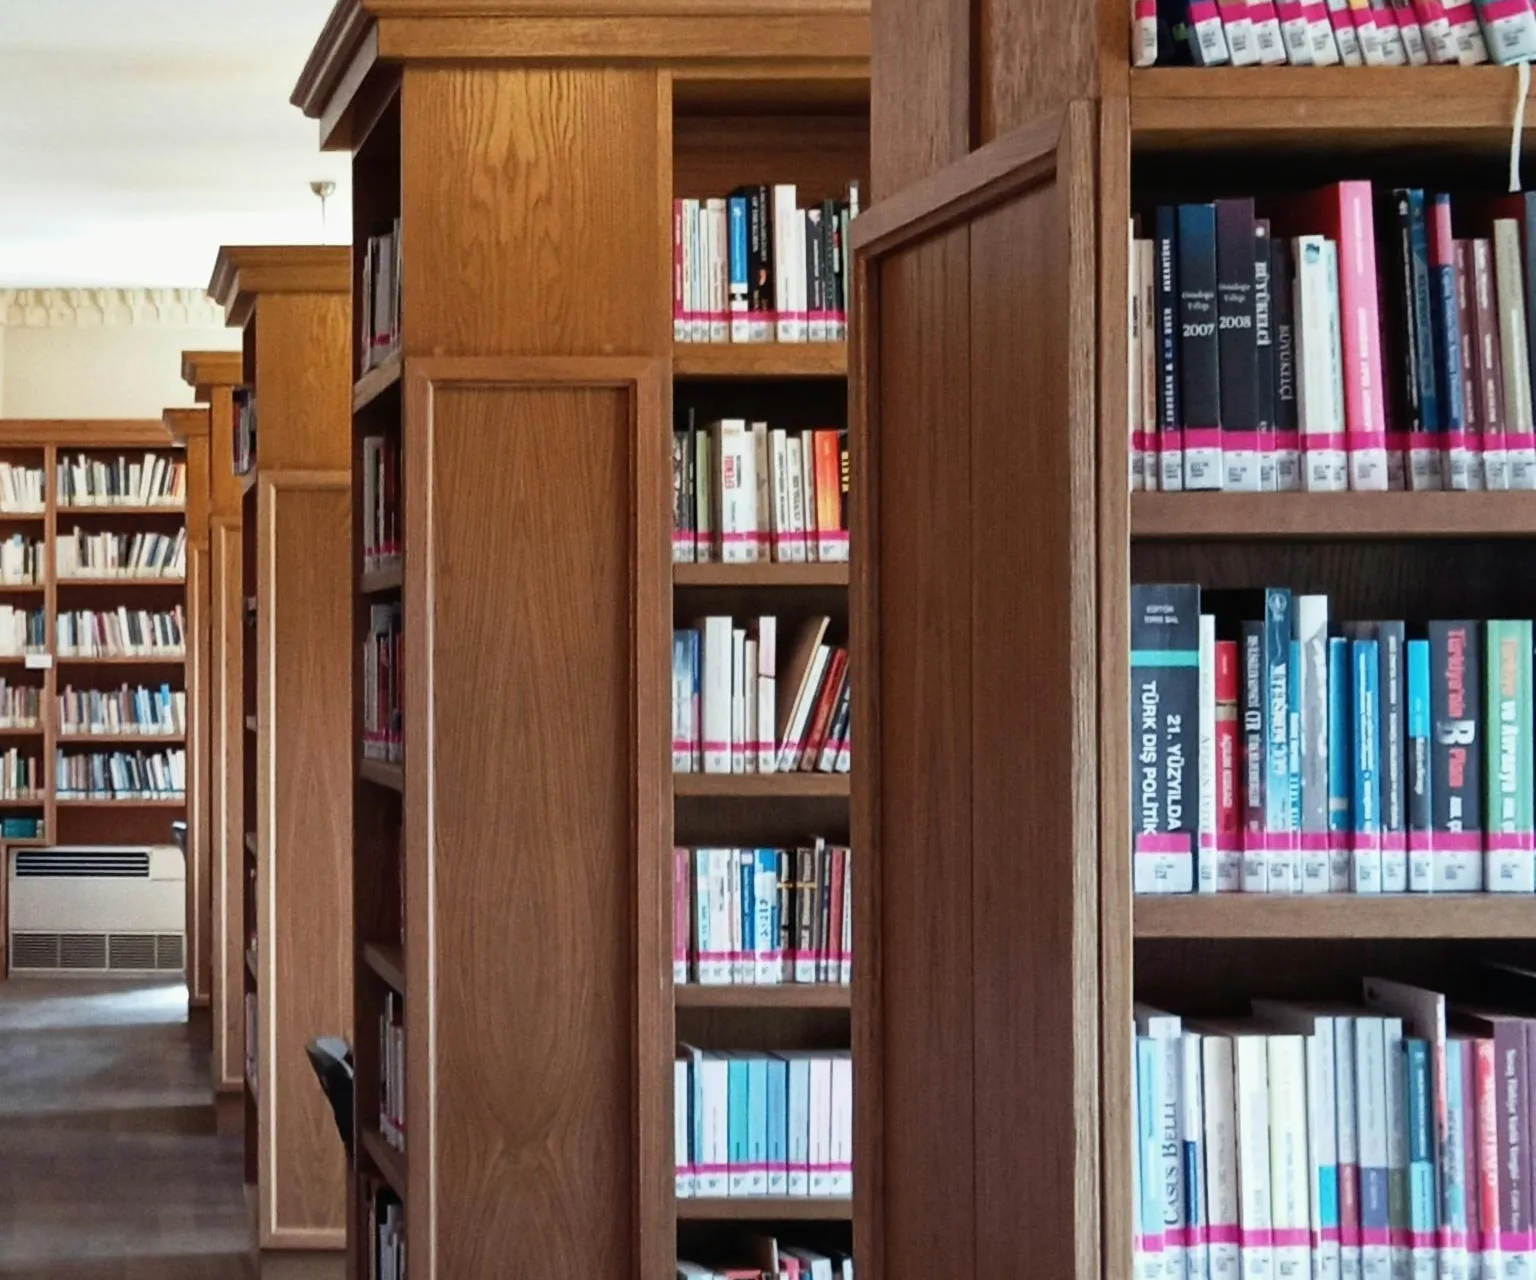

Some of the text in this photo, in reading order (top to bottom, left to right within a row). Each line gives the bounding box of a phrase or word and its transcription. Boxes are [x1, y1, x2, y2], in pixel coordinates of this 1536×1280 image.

[1182, 322, 1216, 337] 2007
[1218, 314, 1252, 330] 2008
[1140, 679, 1159, 730] TÜRK
[1436, 719, 1476, 746] B
[1139, 733, 1157, 763] DIŞ
[1166, 714, 1185, 831] 21. YÜZYILDA
[1163, 1166, 1180, 1226] CASUS
